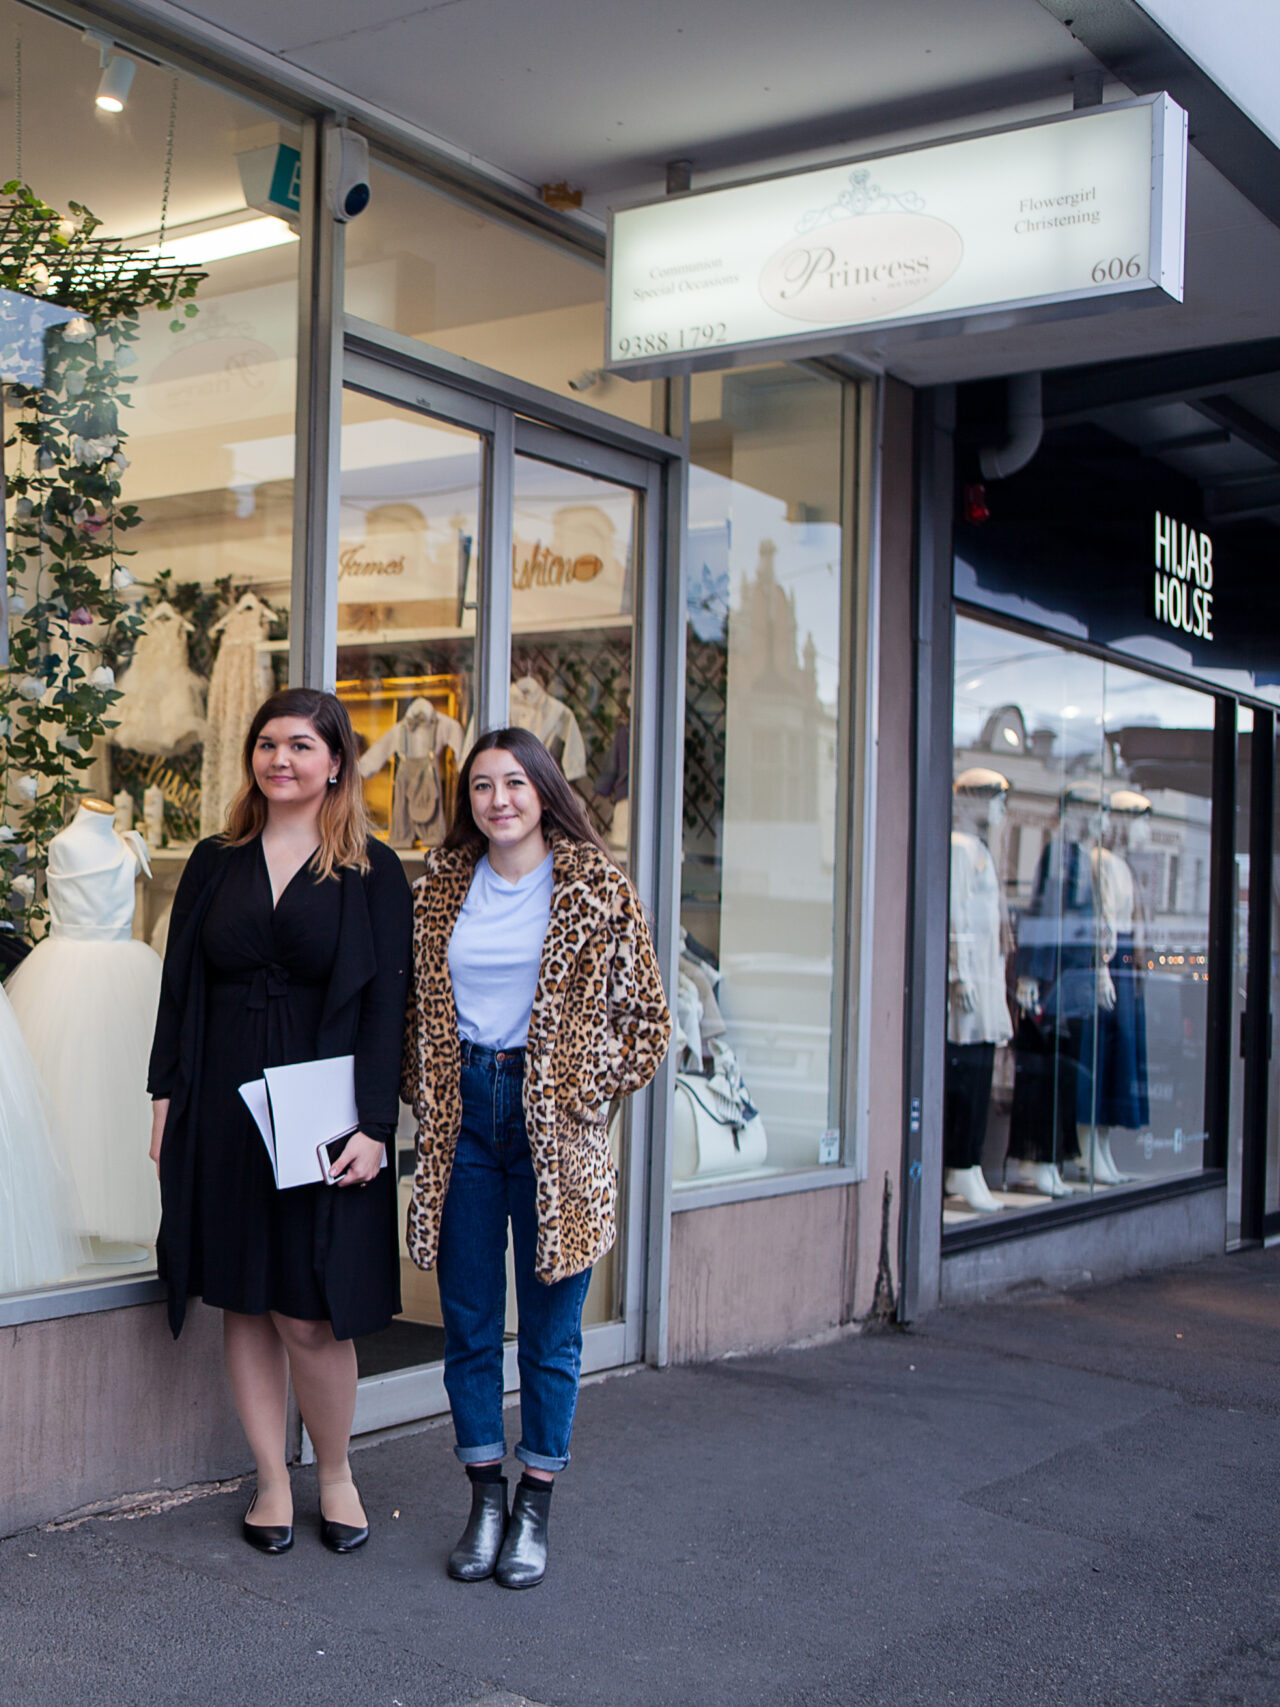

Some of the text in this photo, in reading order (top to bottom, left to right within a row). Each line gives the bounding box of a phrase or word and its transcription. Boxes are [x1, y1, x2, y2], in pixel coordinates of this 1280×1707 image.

[1019, 186, 1096, 213] Flowergirl
[1013, 209, 1102, 234] Christening
[779, 246, 930, 300] Princess
[1090, 252, 1142, 283] 606
[619, 322, 727, 357] 9388 1792
[1154, 510, 1214, 590] HIJAB
[1154, 570, 1214, 642] HOUSE
